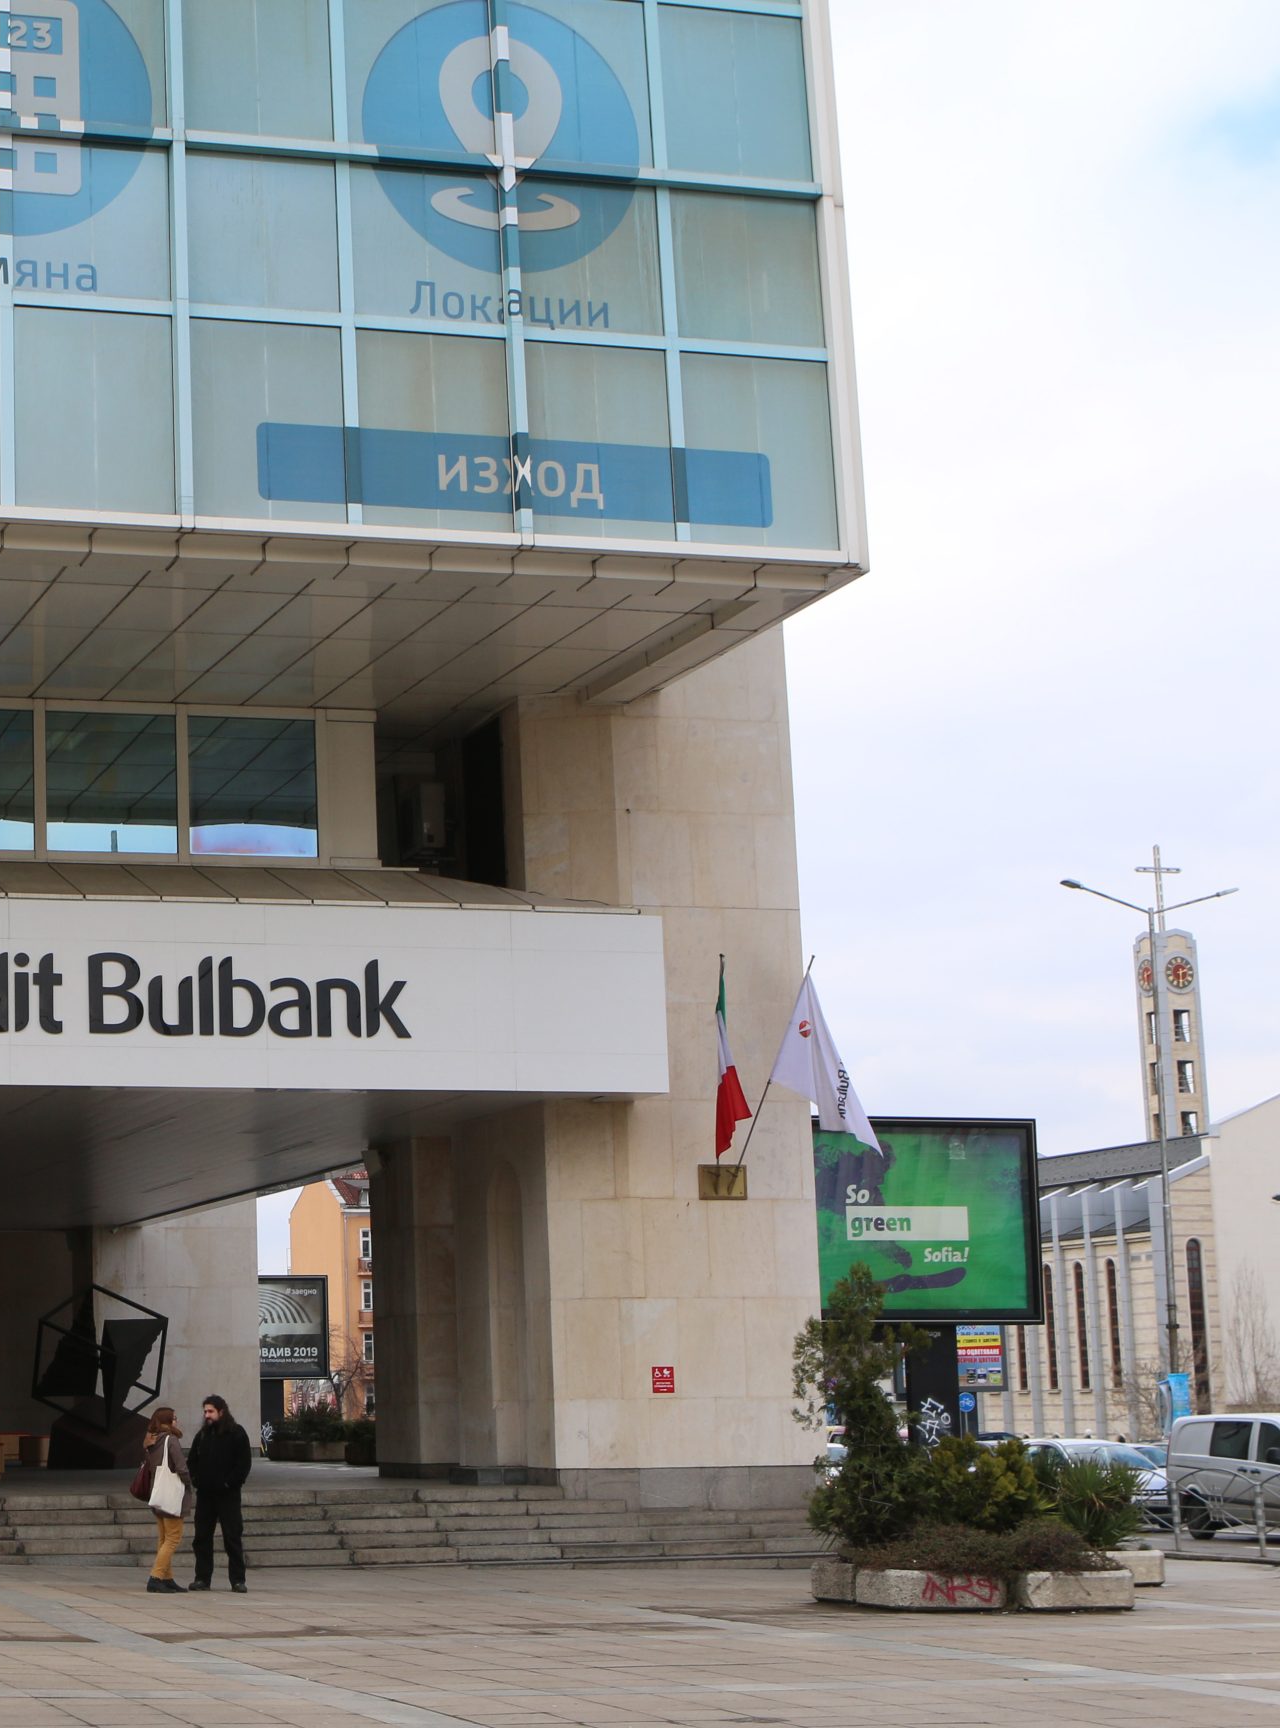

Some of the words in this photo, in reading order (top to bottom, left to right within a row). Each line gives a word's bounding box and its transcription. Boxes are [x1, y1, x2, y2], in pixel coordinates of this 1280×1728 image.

[409, 280, 610, 330] Локации
[437, 454, 604, 510] ИЗХОД
[88, 952, 413, 1039] Bulbank
[845, 1184, 870, 1204] So
[851, 1216, 912, 1237] green
[923, 1247, 969, 1263] Sofia!
[293, 1347, 318, 1357] 2019
